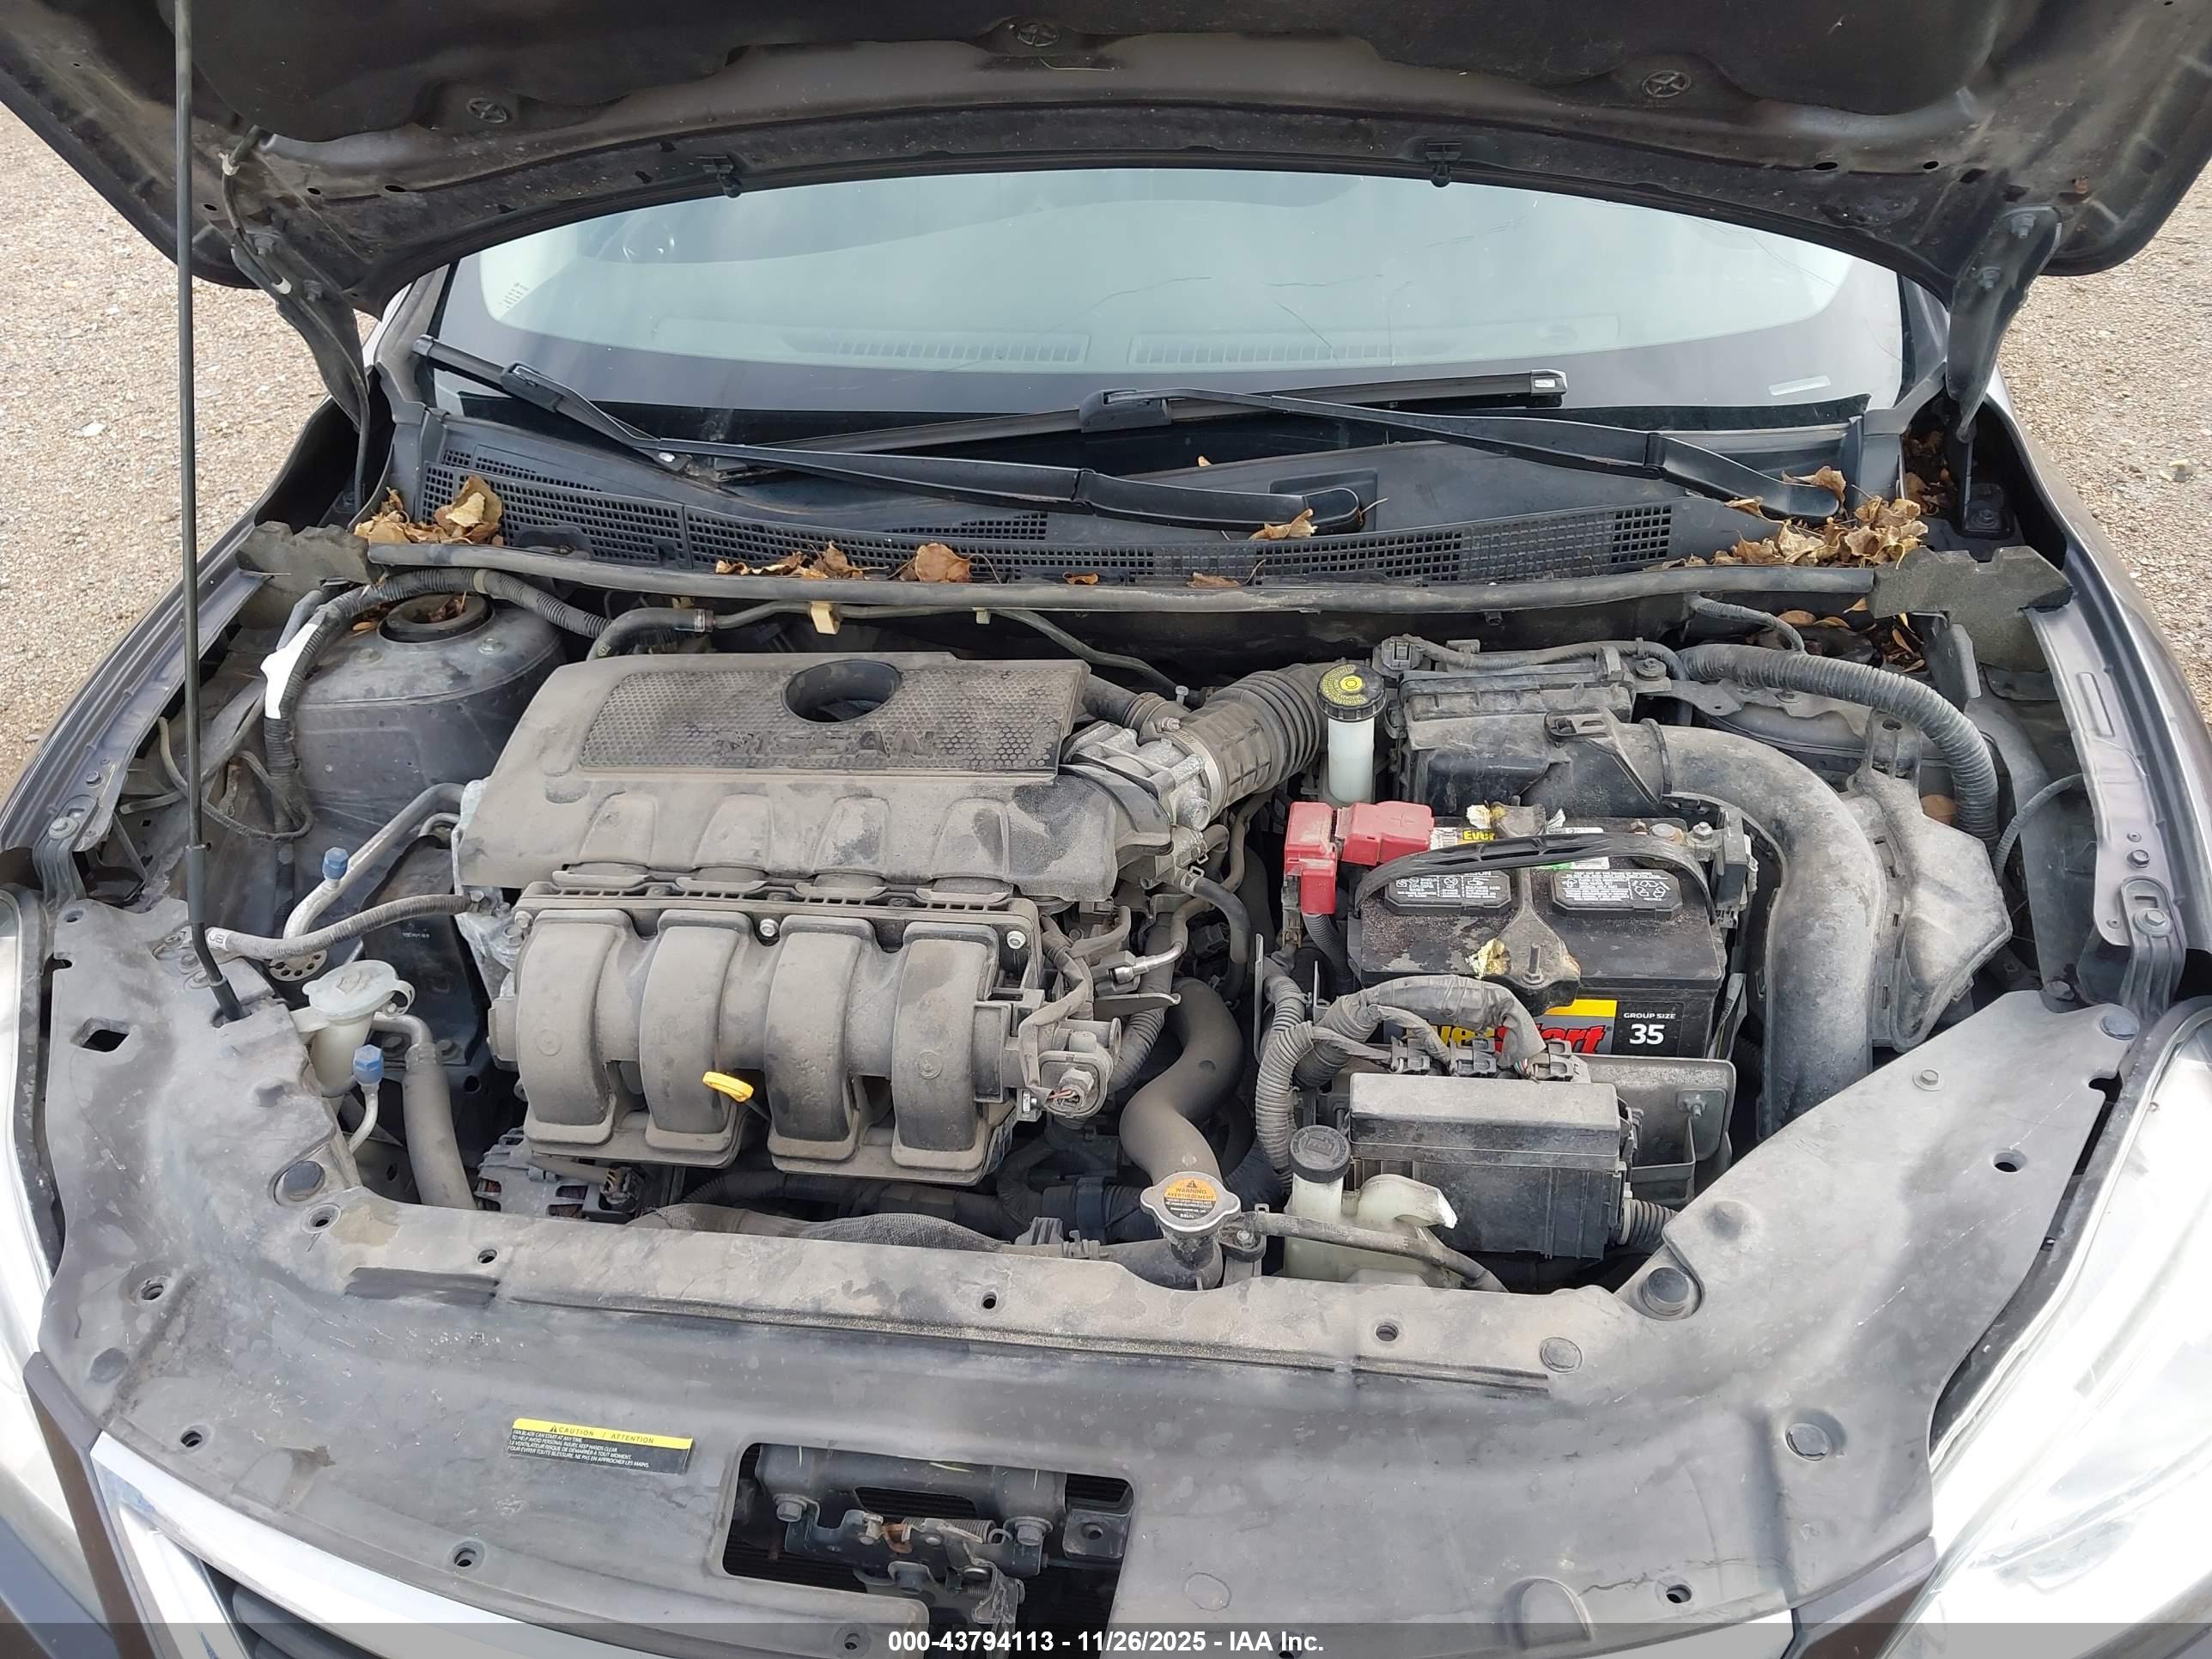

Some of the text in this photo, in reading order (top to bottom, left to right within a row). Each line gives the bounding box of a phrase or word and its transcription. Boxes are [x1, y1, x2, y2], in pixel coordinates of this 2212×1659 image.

[714, 730, 935, 759] NISSAN
[1629, 1024, 1665, 1045] 35
[558, 1426, 594, 1437] CAUTION
[611, 1433, 654, 1443] ATTENTION
